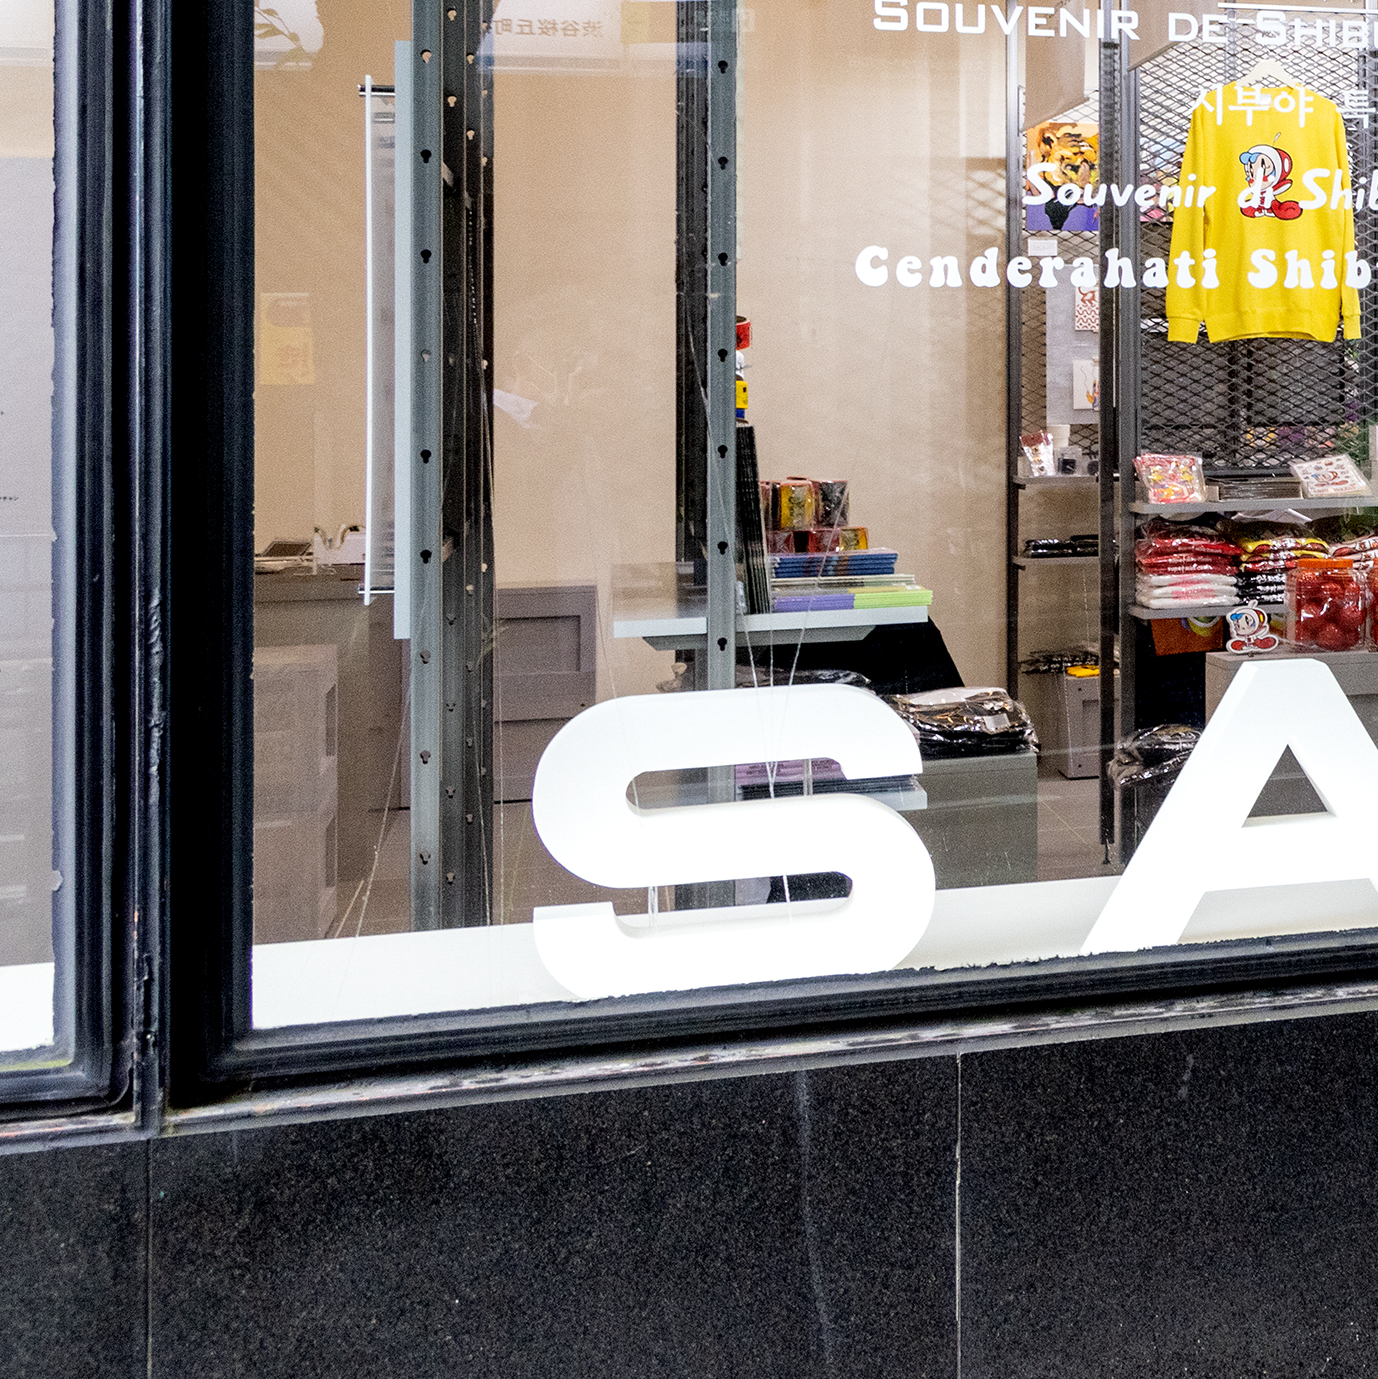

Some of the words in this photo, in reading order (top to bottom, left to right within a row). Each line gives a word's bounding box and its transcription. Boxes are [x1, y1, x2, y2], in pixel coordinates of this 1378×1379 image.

[1167, 11, 1227, 43] DE
[1189, 82, 1314, 128] 시부야
[1020, 162, 1218, 212] Souvenir
[1237, 168, 1275, 212] di
[855, 244, 1221, 291] Cenderahati
